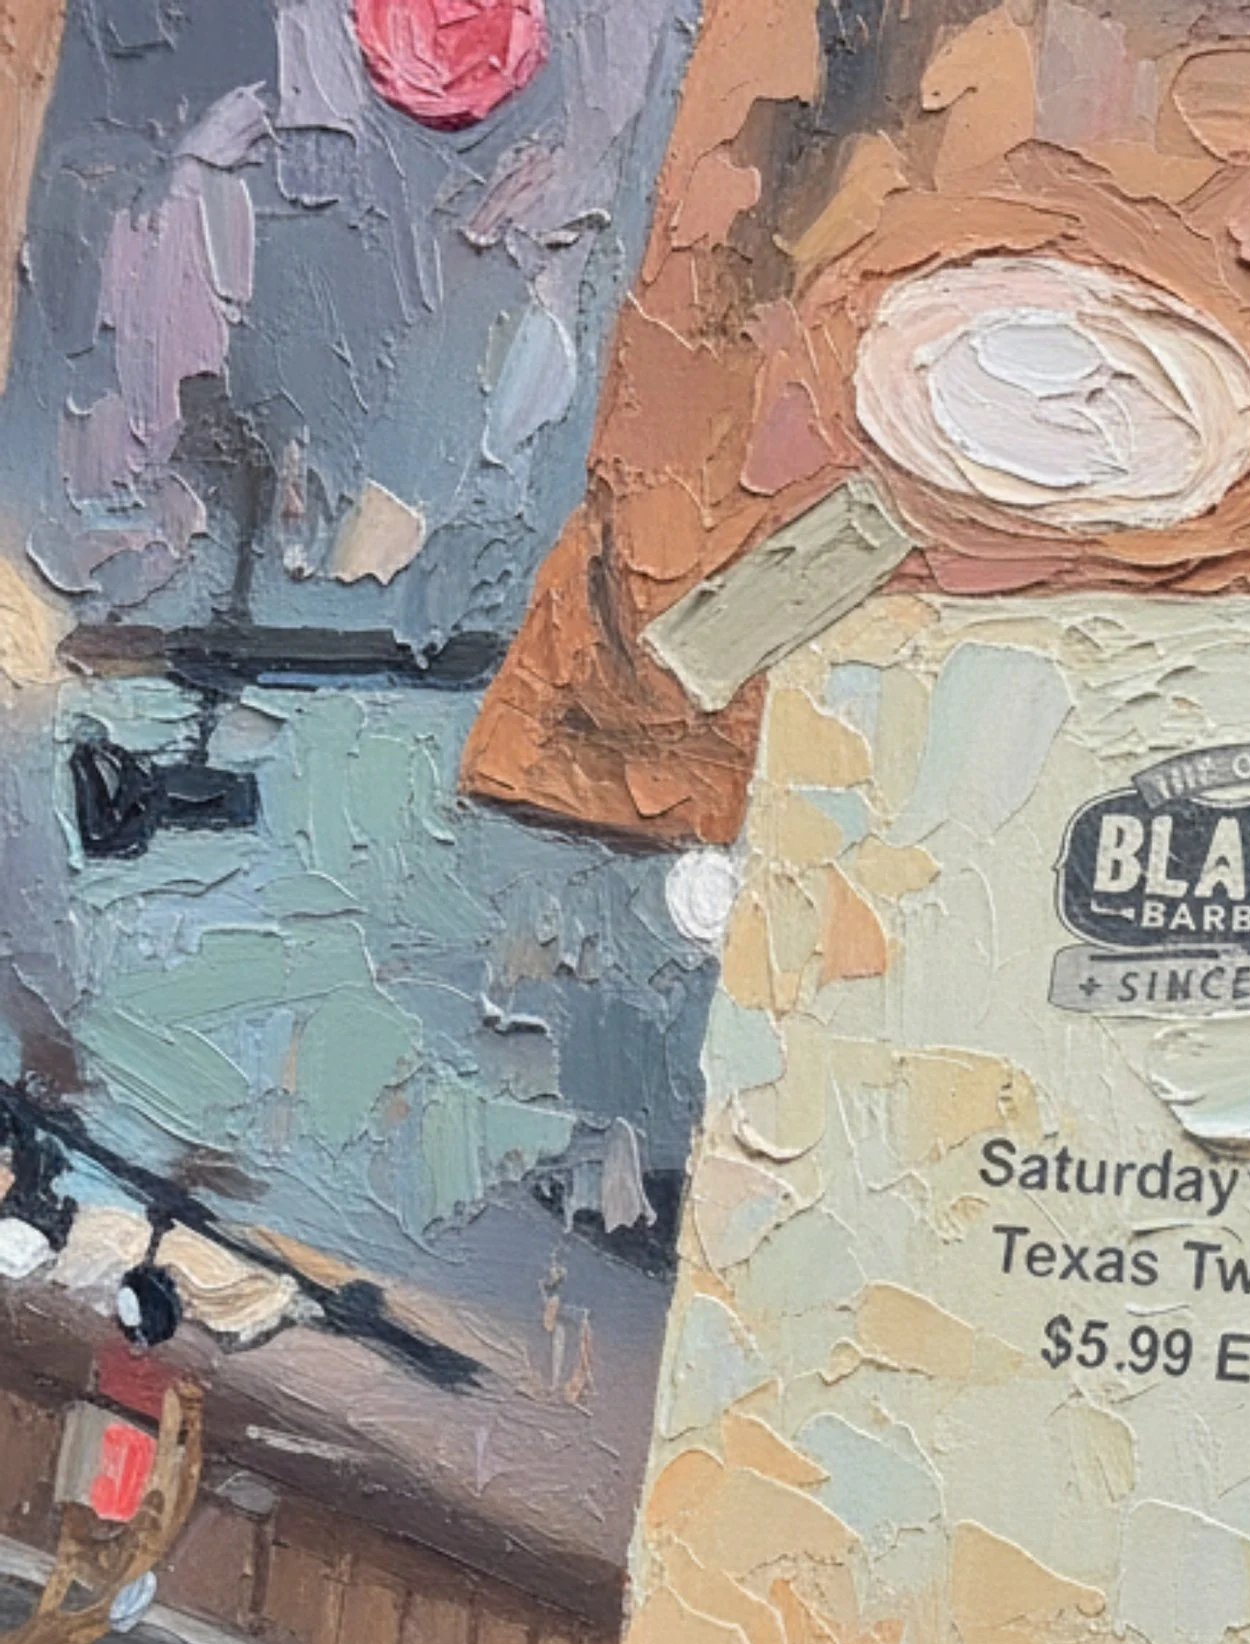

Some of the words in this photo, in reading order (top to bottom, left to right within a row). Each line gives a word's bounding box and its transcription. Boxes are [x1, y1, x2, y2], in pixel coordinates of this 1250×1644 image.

[979, 1137, 1239, 1216] Saturday
[993, 1224, 1159, 1286] Texas
[1041, 1314, 1193, 1376] $5.99
